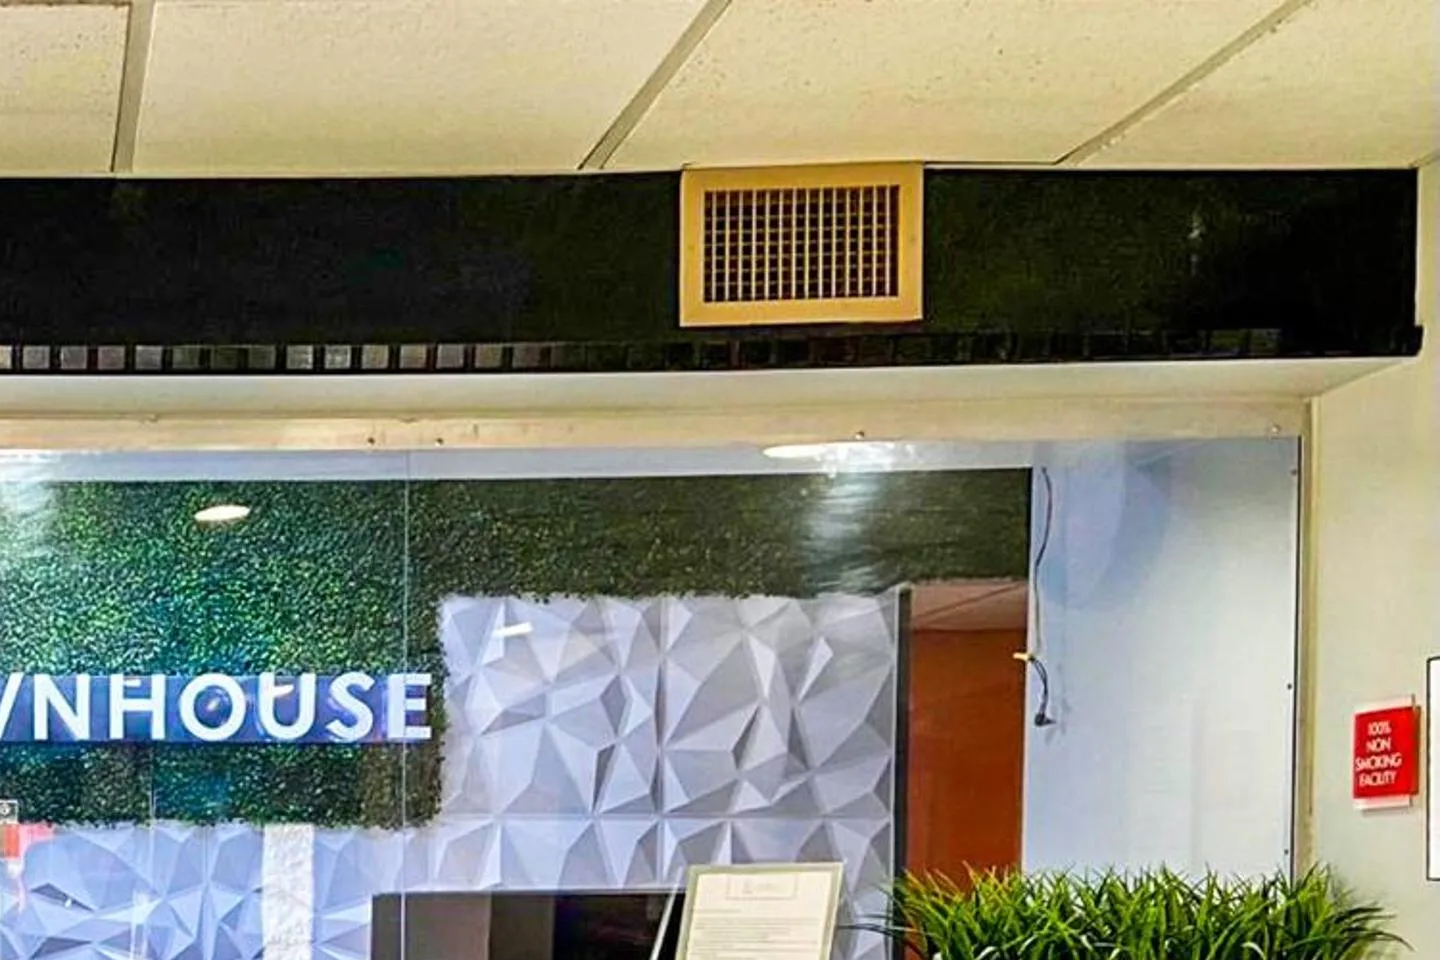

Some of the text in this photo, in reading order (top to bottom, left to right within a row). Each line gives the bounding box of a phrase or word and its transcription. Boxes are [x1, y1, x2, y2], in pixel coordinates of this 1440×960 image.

[1366, 737, 1391, 753] NON
[1355, 752, 1402, 771] SMOKING
[1359, 770, 1397, 787] FACILITY
